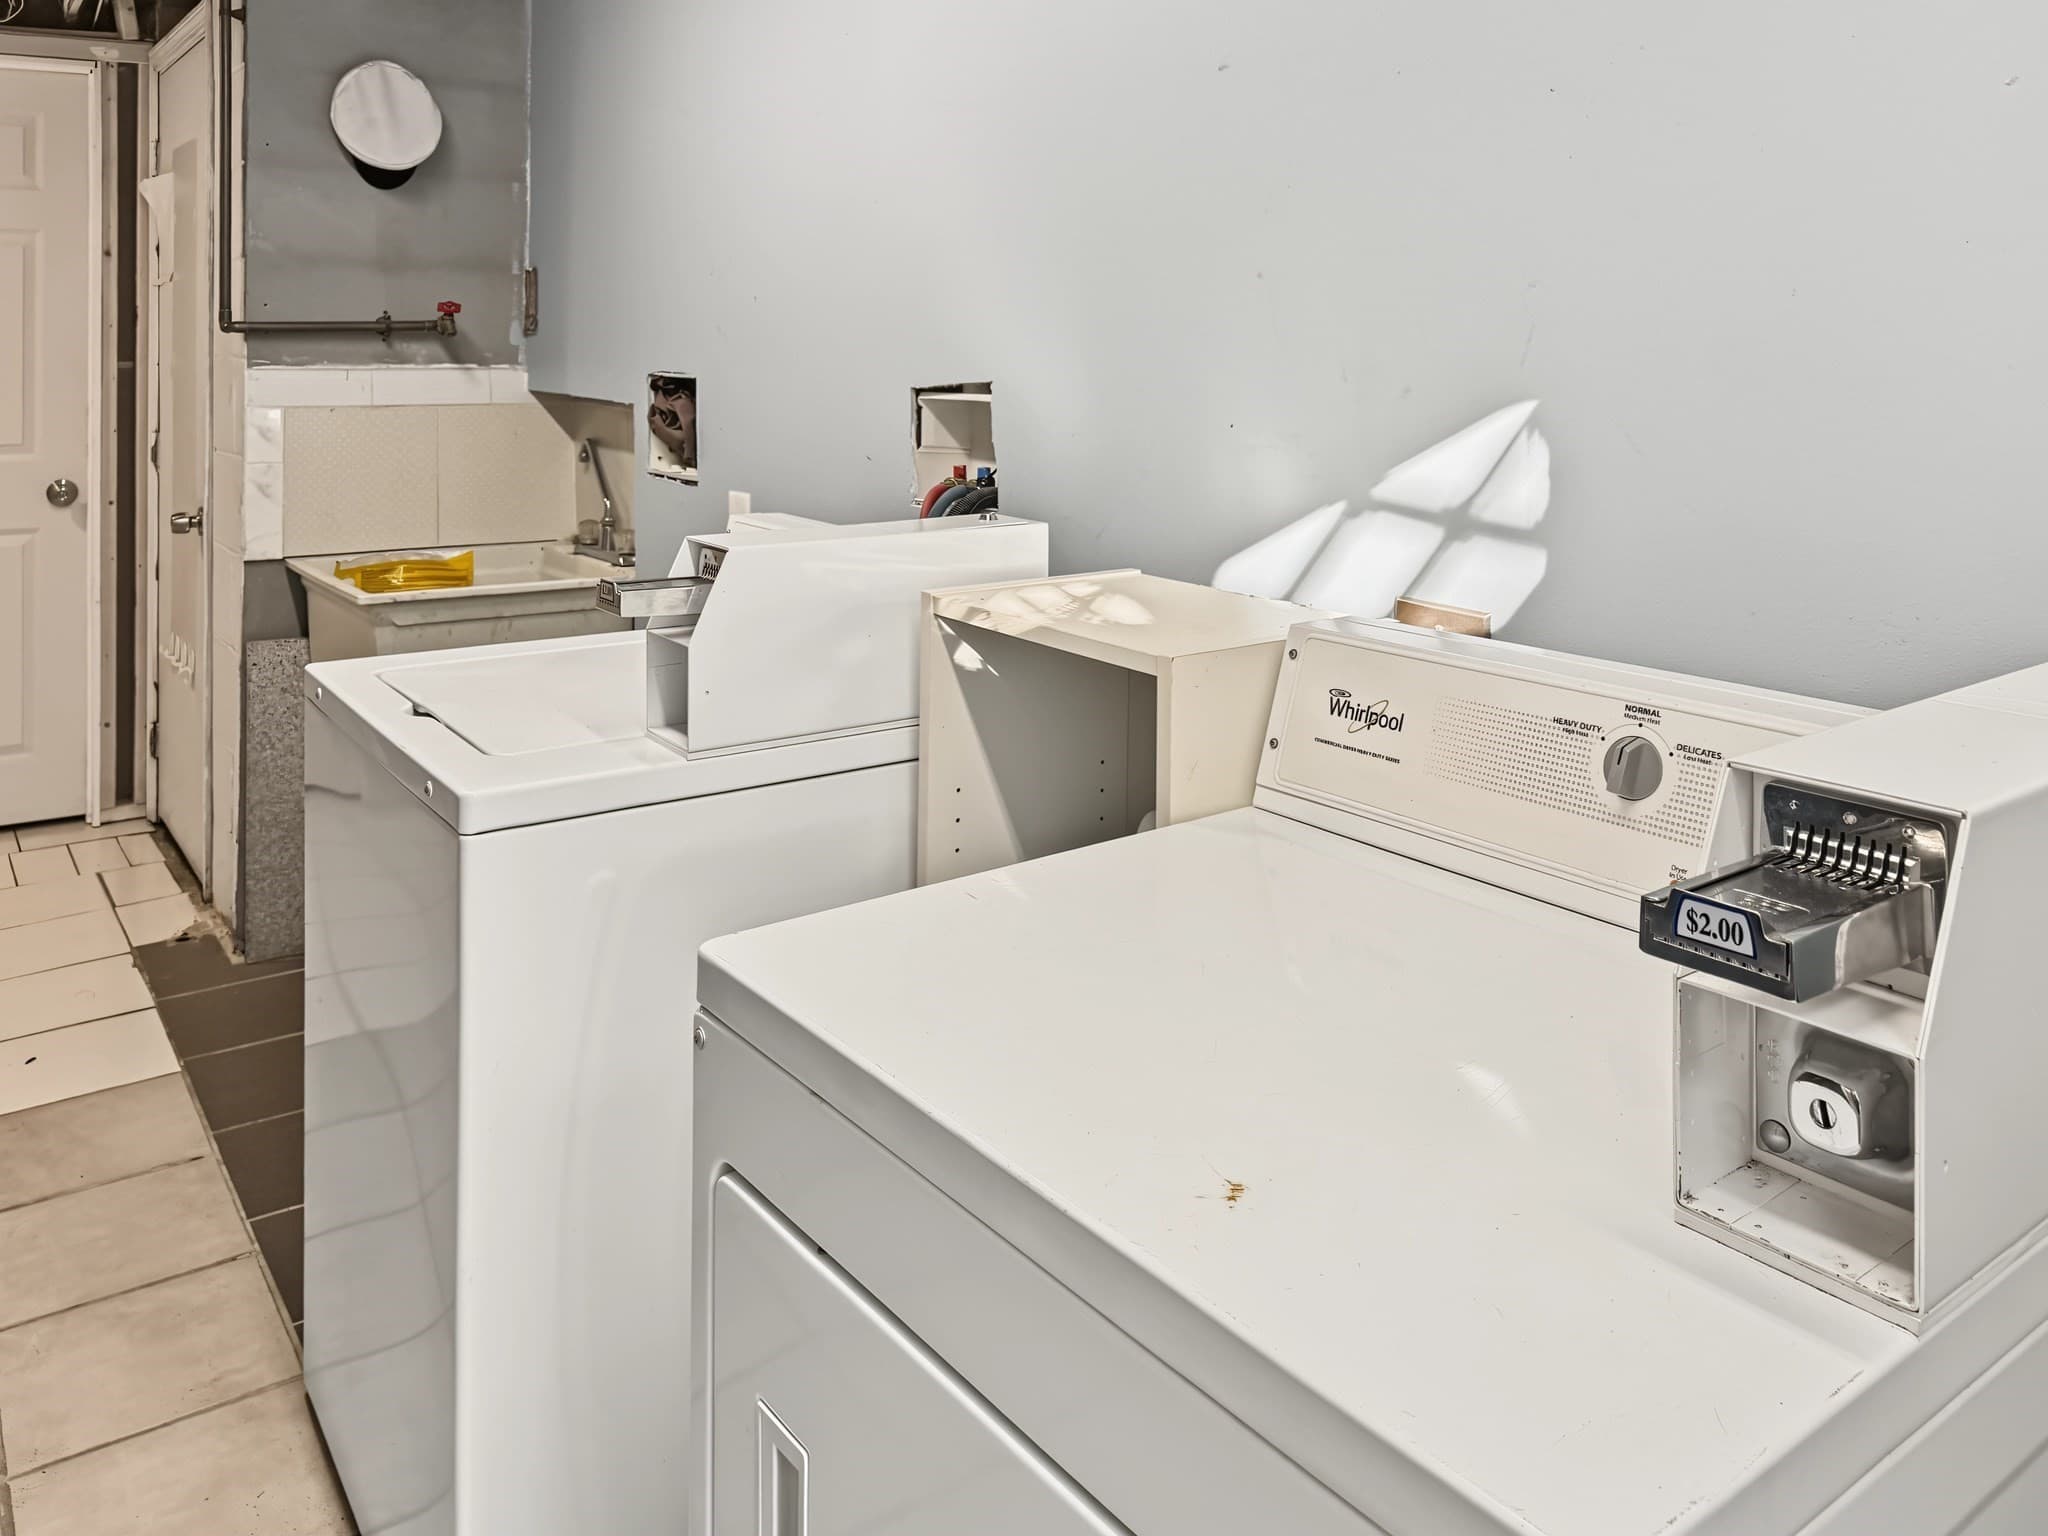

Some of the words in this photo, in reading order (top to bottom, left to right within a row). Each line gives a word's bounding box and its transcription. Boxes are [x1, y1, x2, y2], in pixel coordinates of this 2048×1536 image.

[1329, 696, 1405, 732] Whirlpool
[1624, 704, 1662, 718] NORMAL
[1552, 716, 1579, 728] HEAVY
[1579, 722, 1603, 734] DUTY
[1676, 743, 1722, 760] DELICATES
[1686, 906, 1744, 946] $2.00
